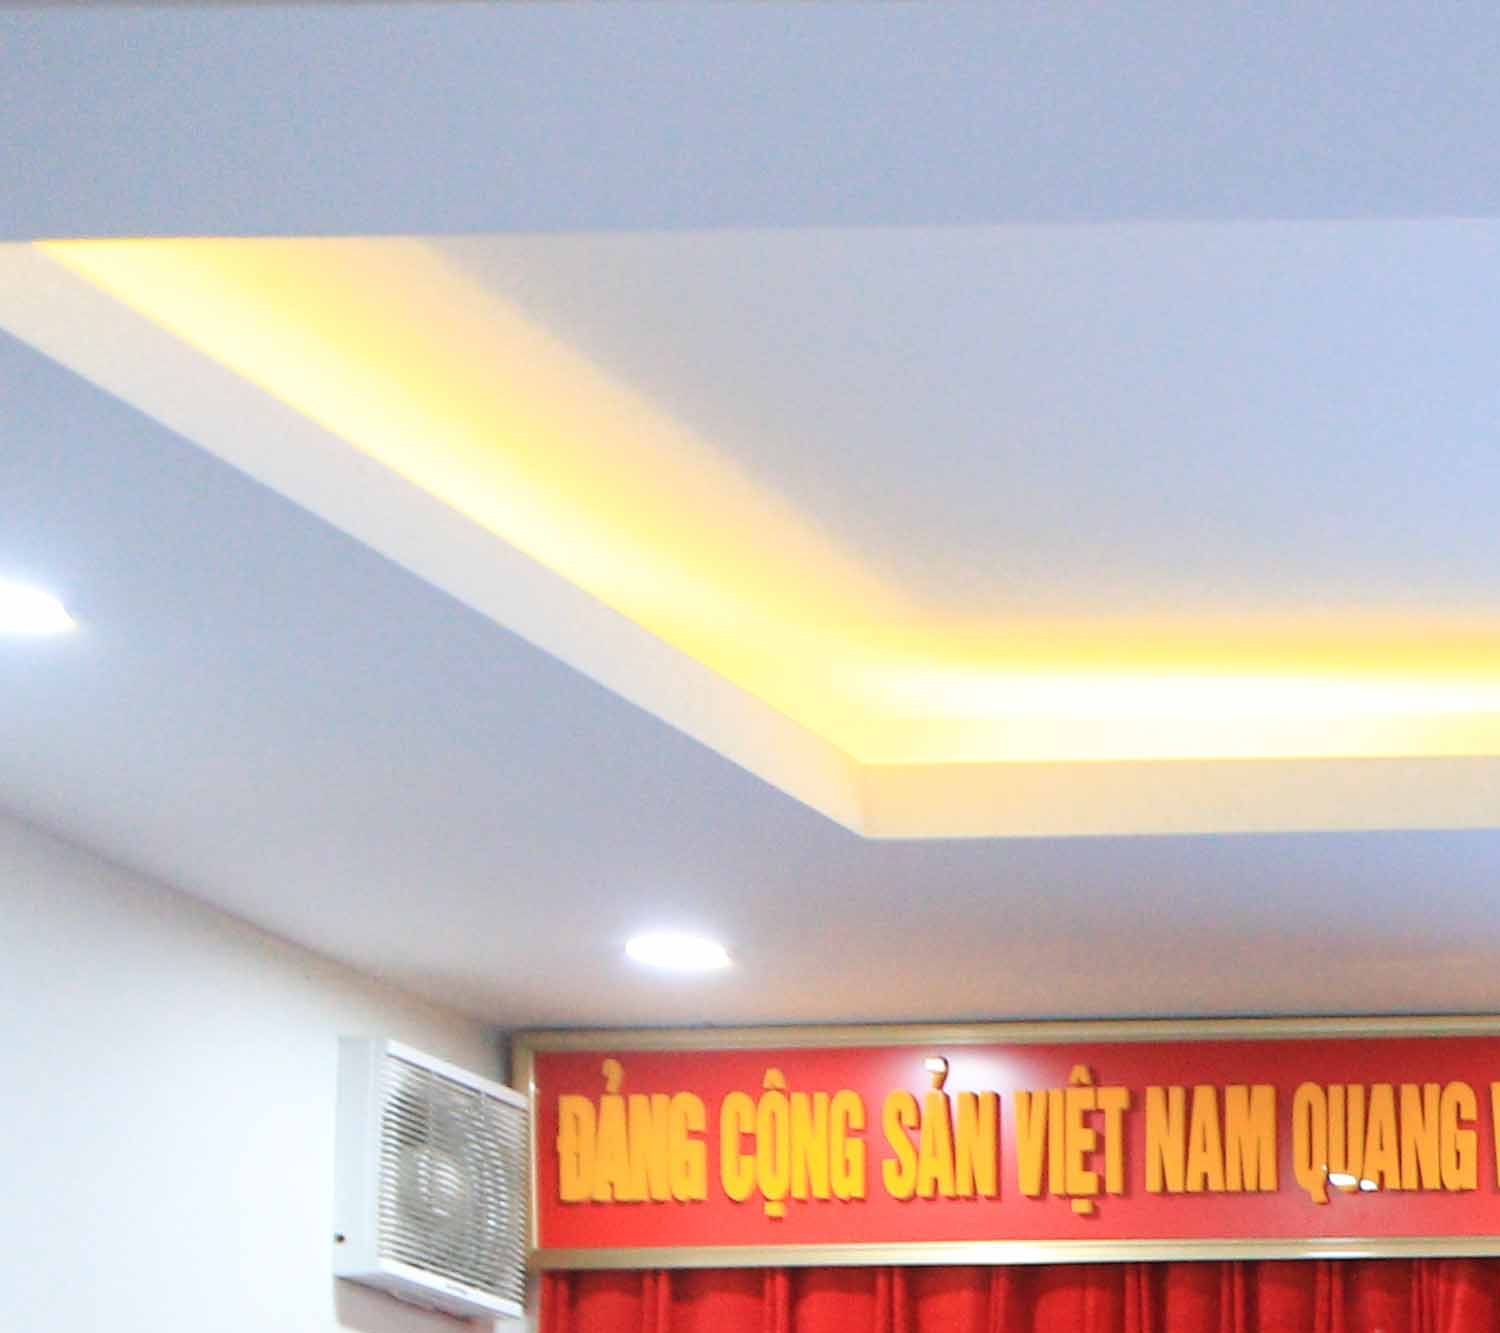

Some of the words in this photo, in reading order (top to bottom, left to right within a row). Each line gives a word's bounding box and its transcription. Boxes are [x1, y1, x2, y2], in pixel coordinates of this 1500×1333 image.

[557, 1058, 708, 1204] ĐẢNG
[720, 1067, 866, 1220] CỘNG
[881, 1056, 1000, 1201] SẢN
[1014, 1064, 1131, 1216] VIỆT
[1145, 1084, 1279, 1194] NAM
[1291, 1081, 1478, 1205] QUANG
